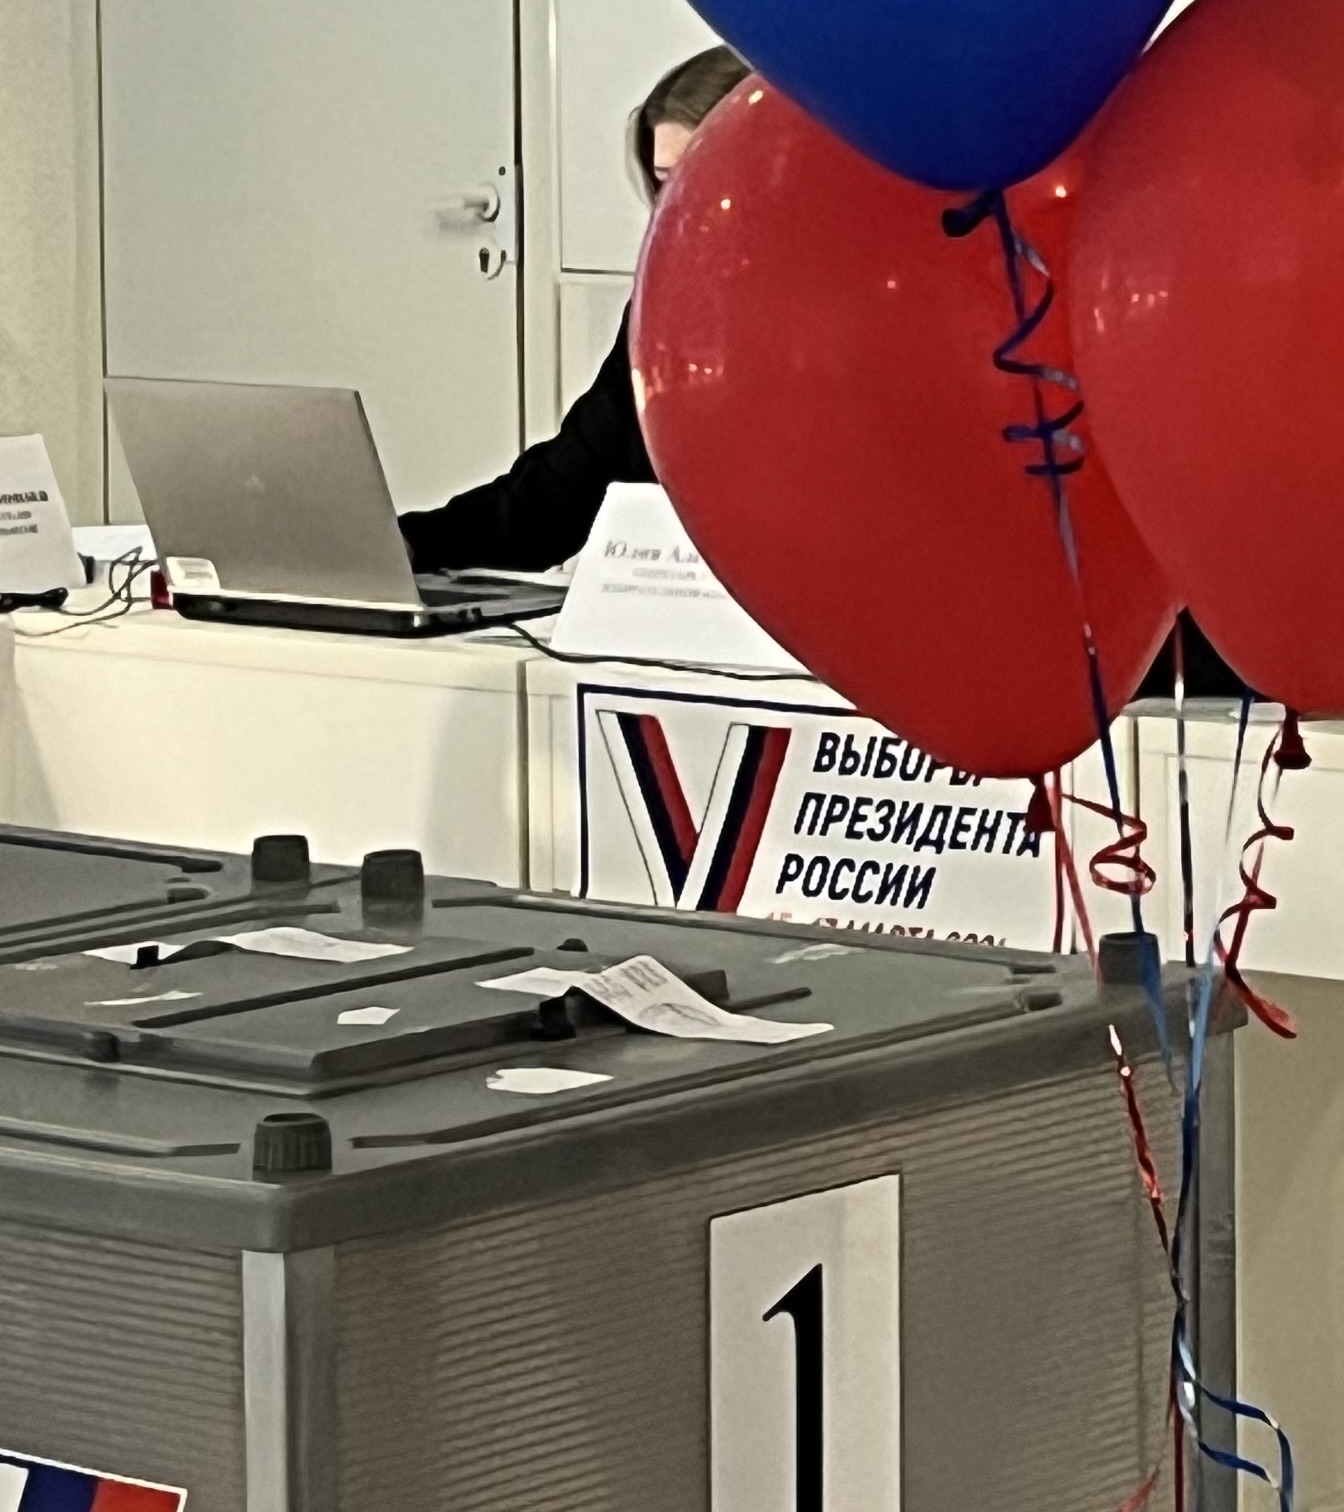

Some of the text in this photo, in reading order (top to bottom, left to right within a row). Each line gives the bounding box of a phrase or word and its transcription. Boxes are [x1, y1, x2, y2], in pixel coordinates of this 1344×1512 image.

[794, 792, 1042, 858] ПРЕЗИДЕНТА
[775, 853, 937, 909] РОССИИ
[762, 1263, 824, 1512] 1
